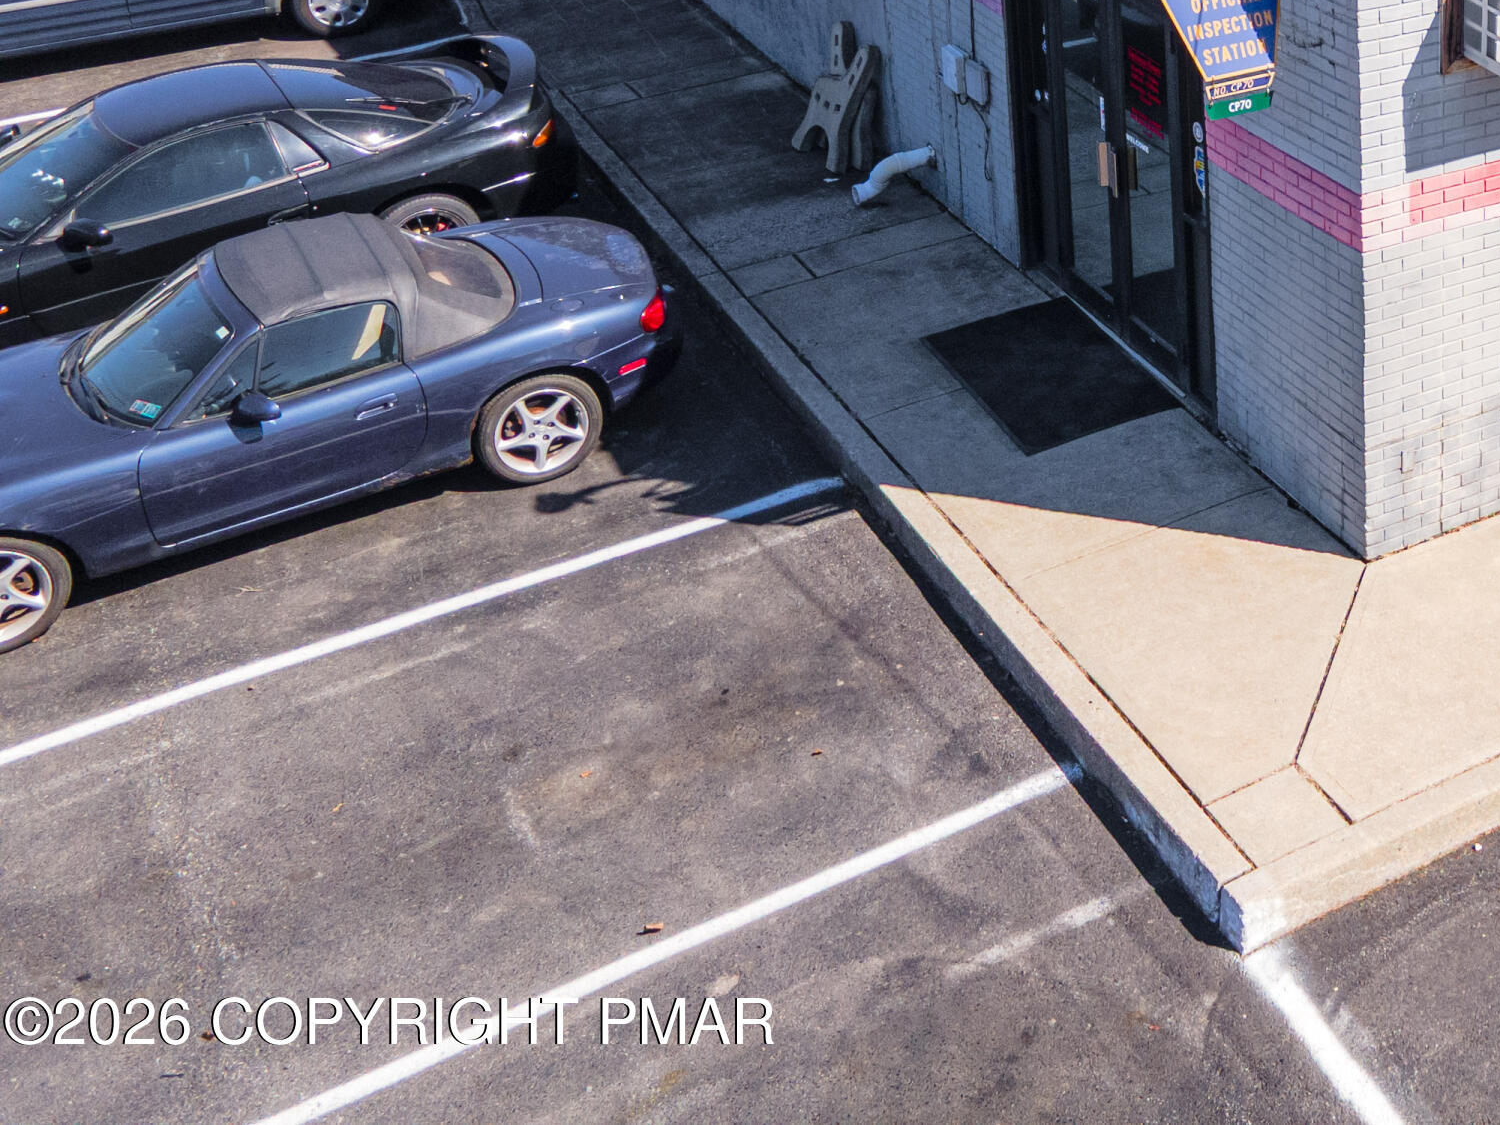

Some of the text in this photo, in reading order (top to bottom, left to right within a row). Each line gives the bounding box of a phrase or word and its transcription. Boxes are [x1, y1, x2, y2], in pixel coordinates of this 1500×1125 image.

[1187, 10, 1273, 42] INSPECTION
[1203, 39, 1266, 67] STATION
[1228, 98, 1252, 113] CP70
